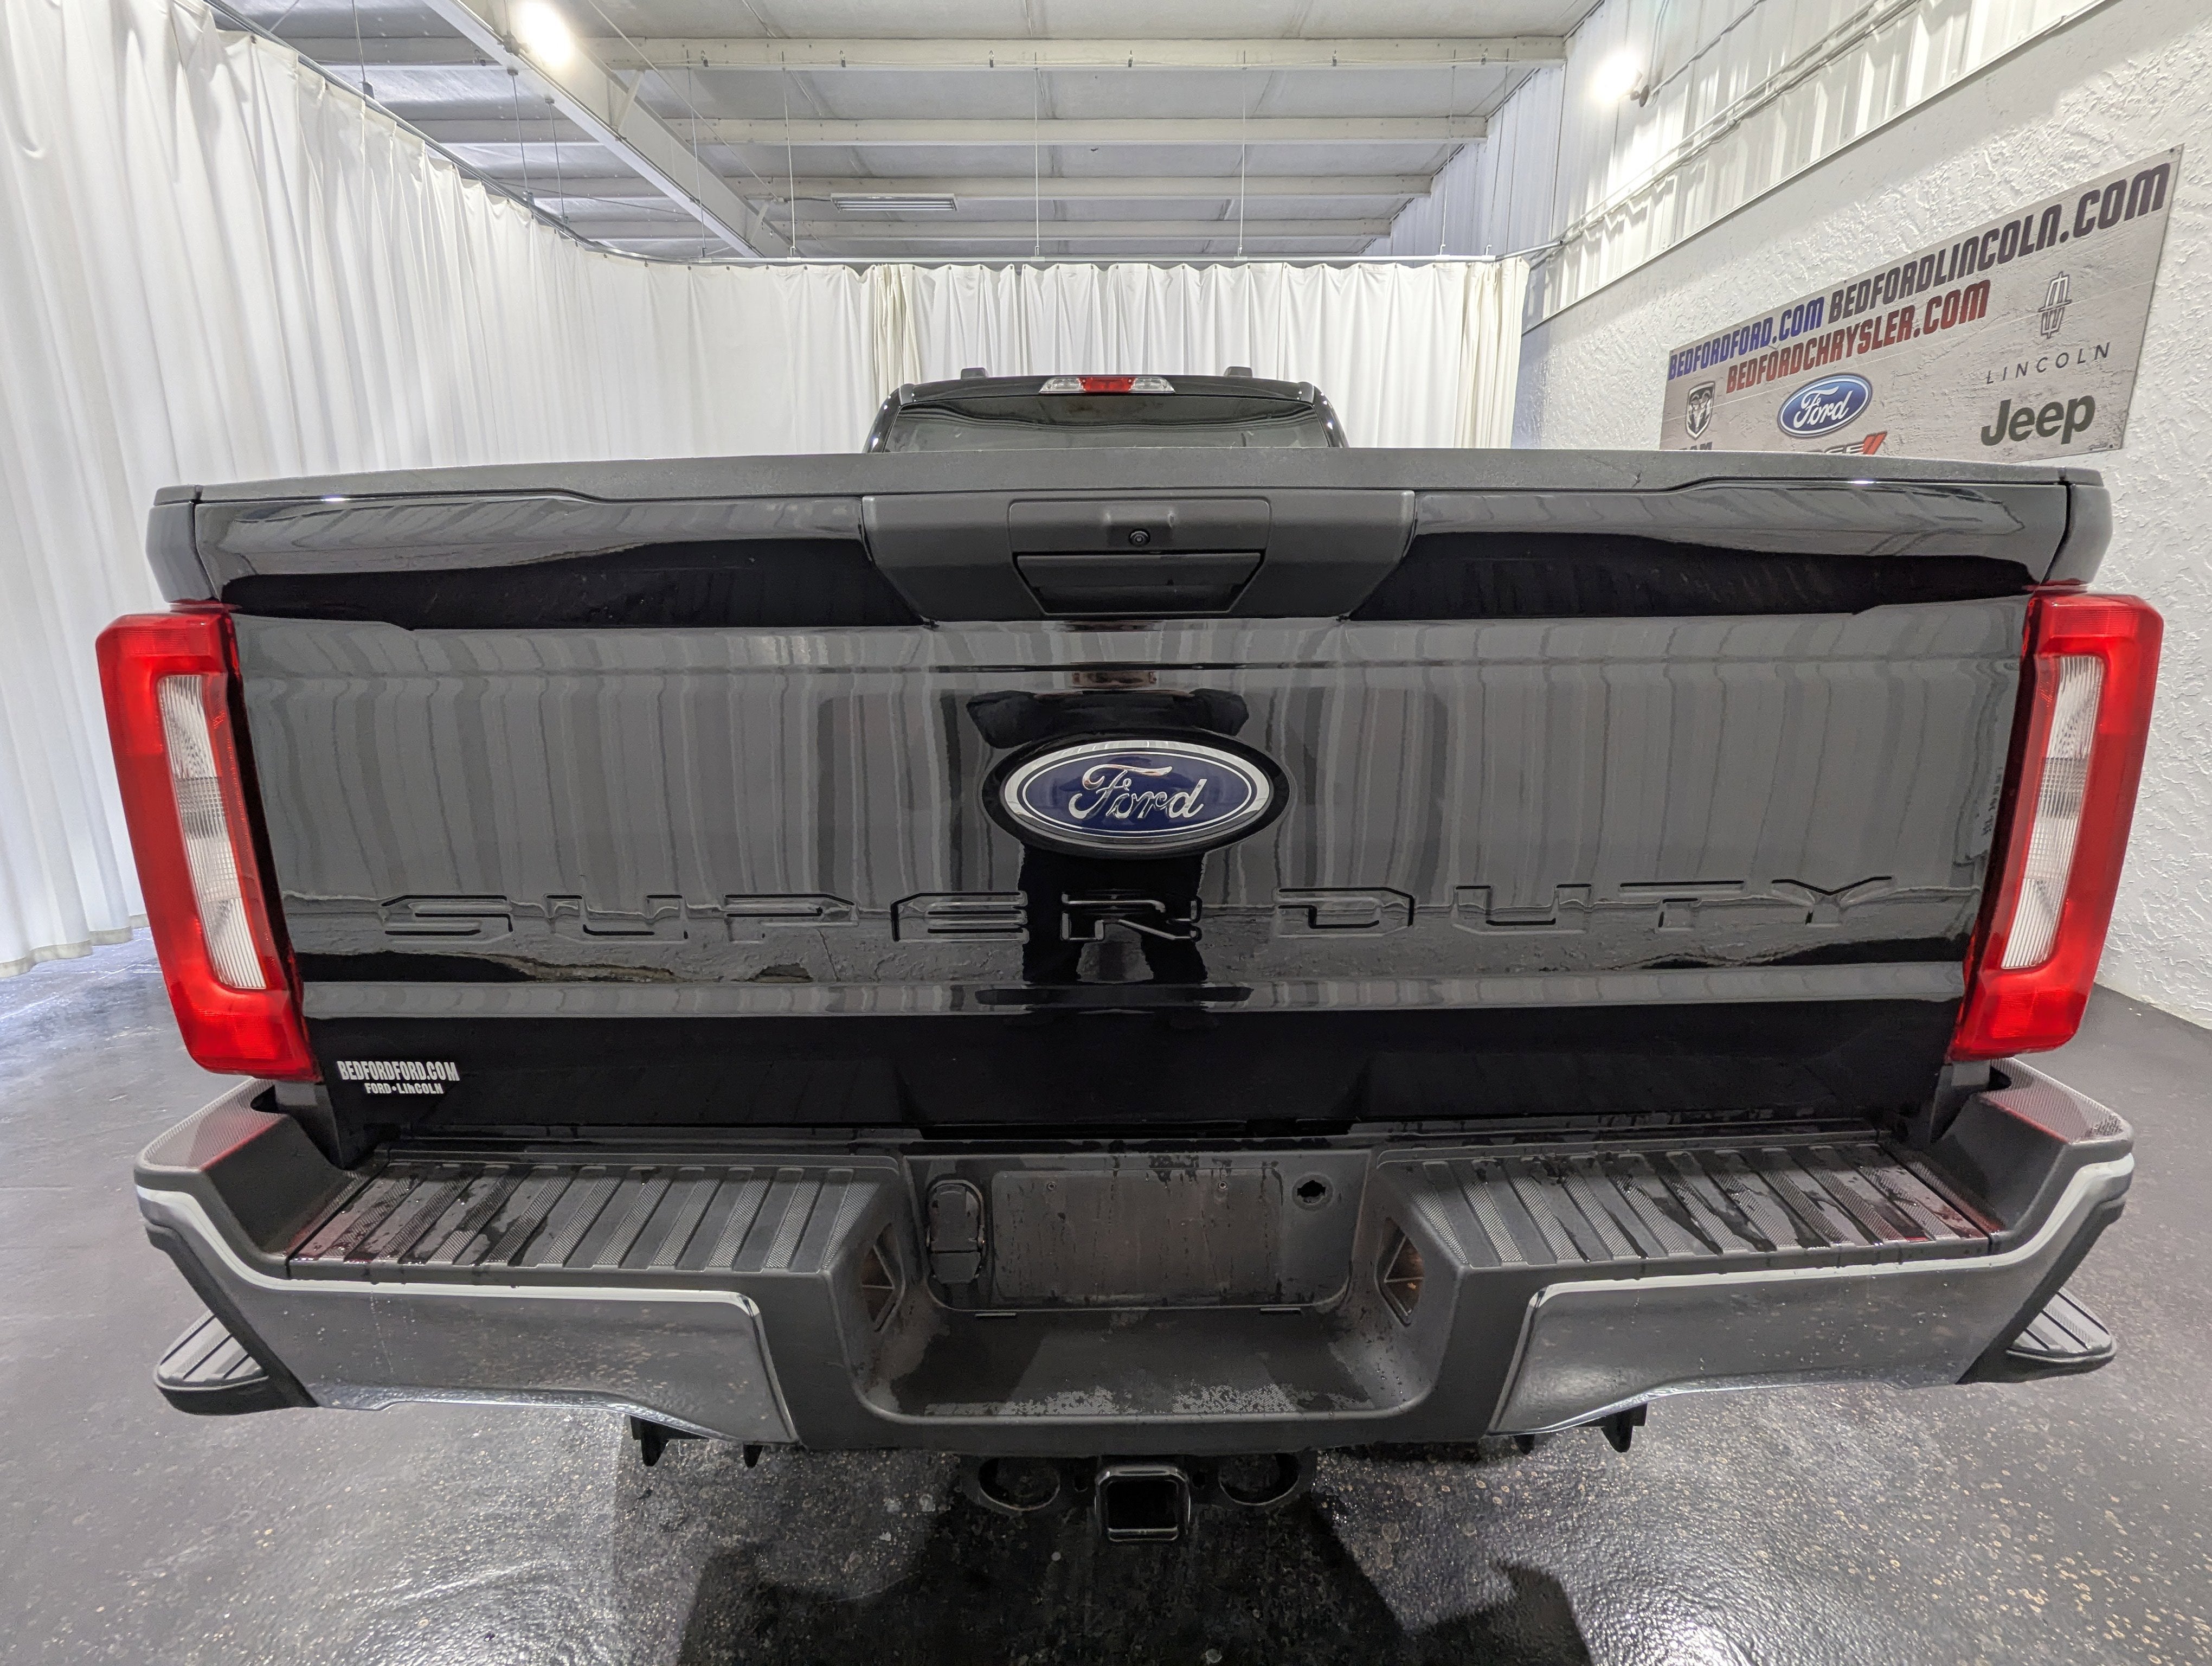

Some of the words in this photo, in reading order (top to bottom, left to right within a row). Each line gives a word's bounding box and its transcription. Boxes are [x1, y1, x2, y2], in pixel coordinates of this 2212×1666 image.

[1668, 297, 1824, 381] BEDFORDFORD.COM
[1828, 163, 2170, 324] BEDFORDLINCOLN.COM
[1726, 279, 1990, 394] BEDFORDCHRYSLER.COM
[1986, 342, 2111, 385] LINCOLN
[1793, 386, 1853, 428] Ford
[1980, 395, 2096, 446] Jeep
[1068, 763, 1207, 819] Ford
[380, 888, 1203, 946] SUPER
[1273, 875, 1894, 939] DUTY
[337, 1061, 460, 1081] BEDFORDFORD.COM
